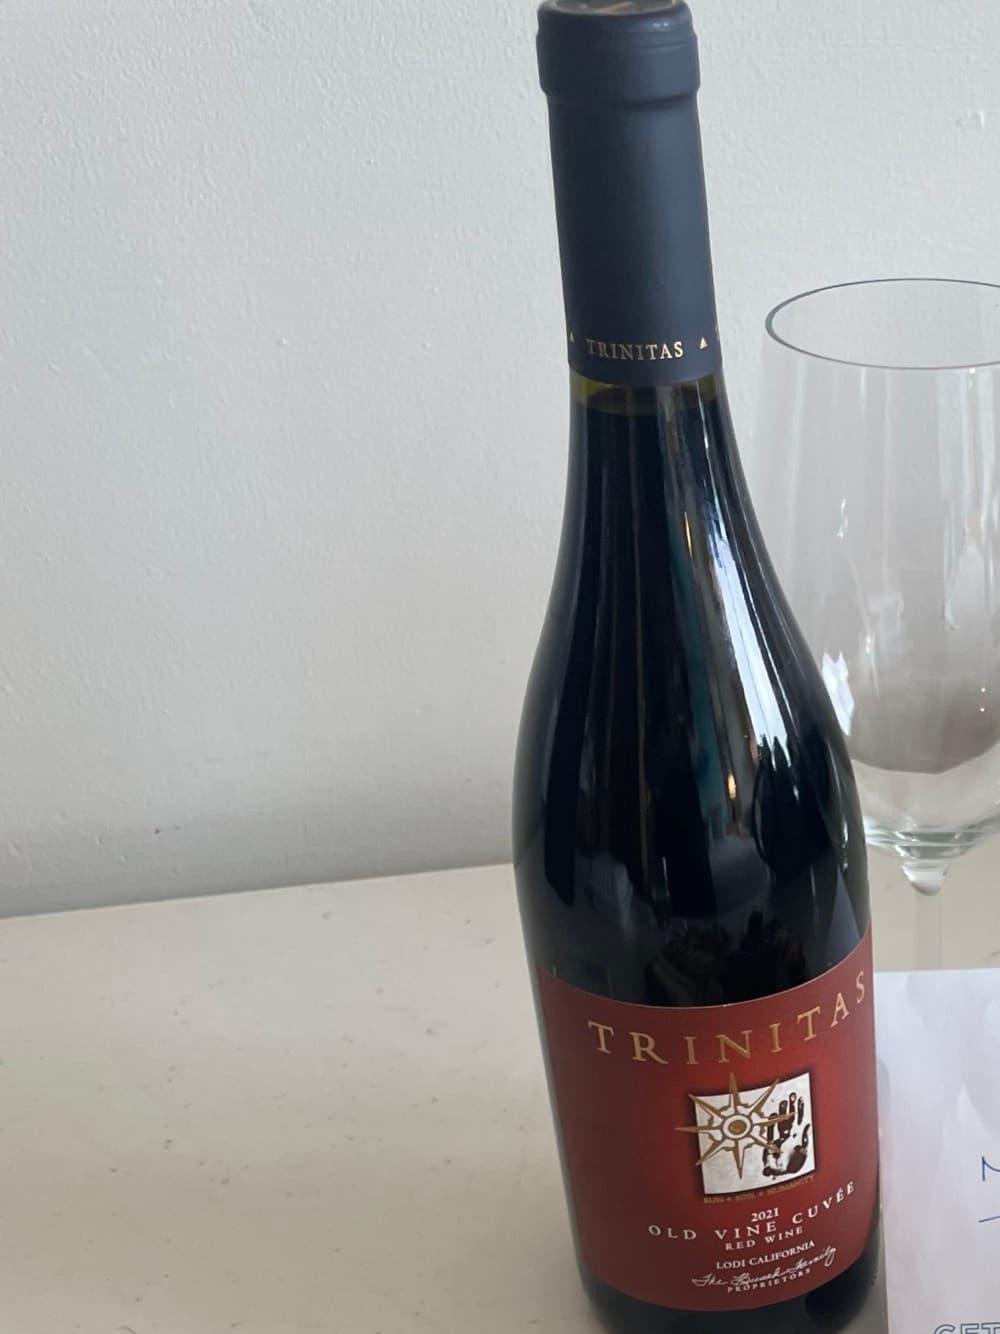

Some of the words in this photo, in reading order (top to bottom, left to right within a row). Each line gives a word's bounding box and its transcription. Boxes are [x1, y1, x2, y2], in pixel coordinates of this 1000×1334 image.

[586, 338, 684, 361] TRINITAS
[587, 969, 867, 1066] TRINITAS
[648, 1224, 697, 1241] OLD
[714, 1220, 778, 1241] VINE
[792, 1181, 855, 1225] CUVÉE
[751, 1207, 780, 1223] 2021
[725, 1239, 756, 1251] RED
[764, 1225, 804, 1245] WINE
[716, 1255, 746, 1270] LODI
[749, 1240, 816, 1266] CALIFORNIA
[691, 1271, 728, 1287] The
[727, 1267, 812, 1293] PROPRIETORS
